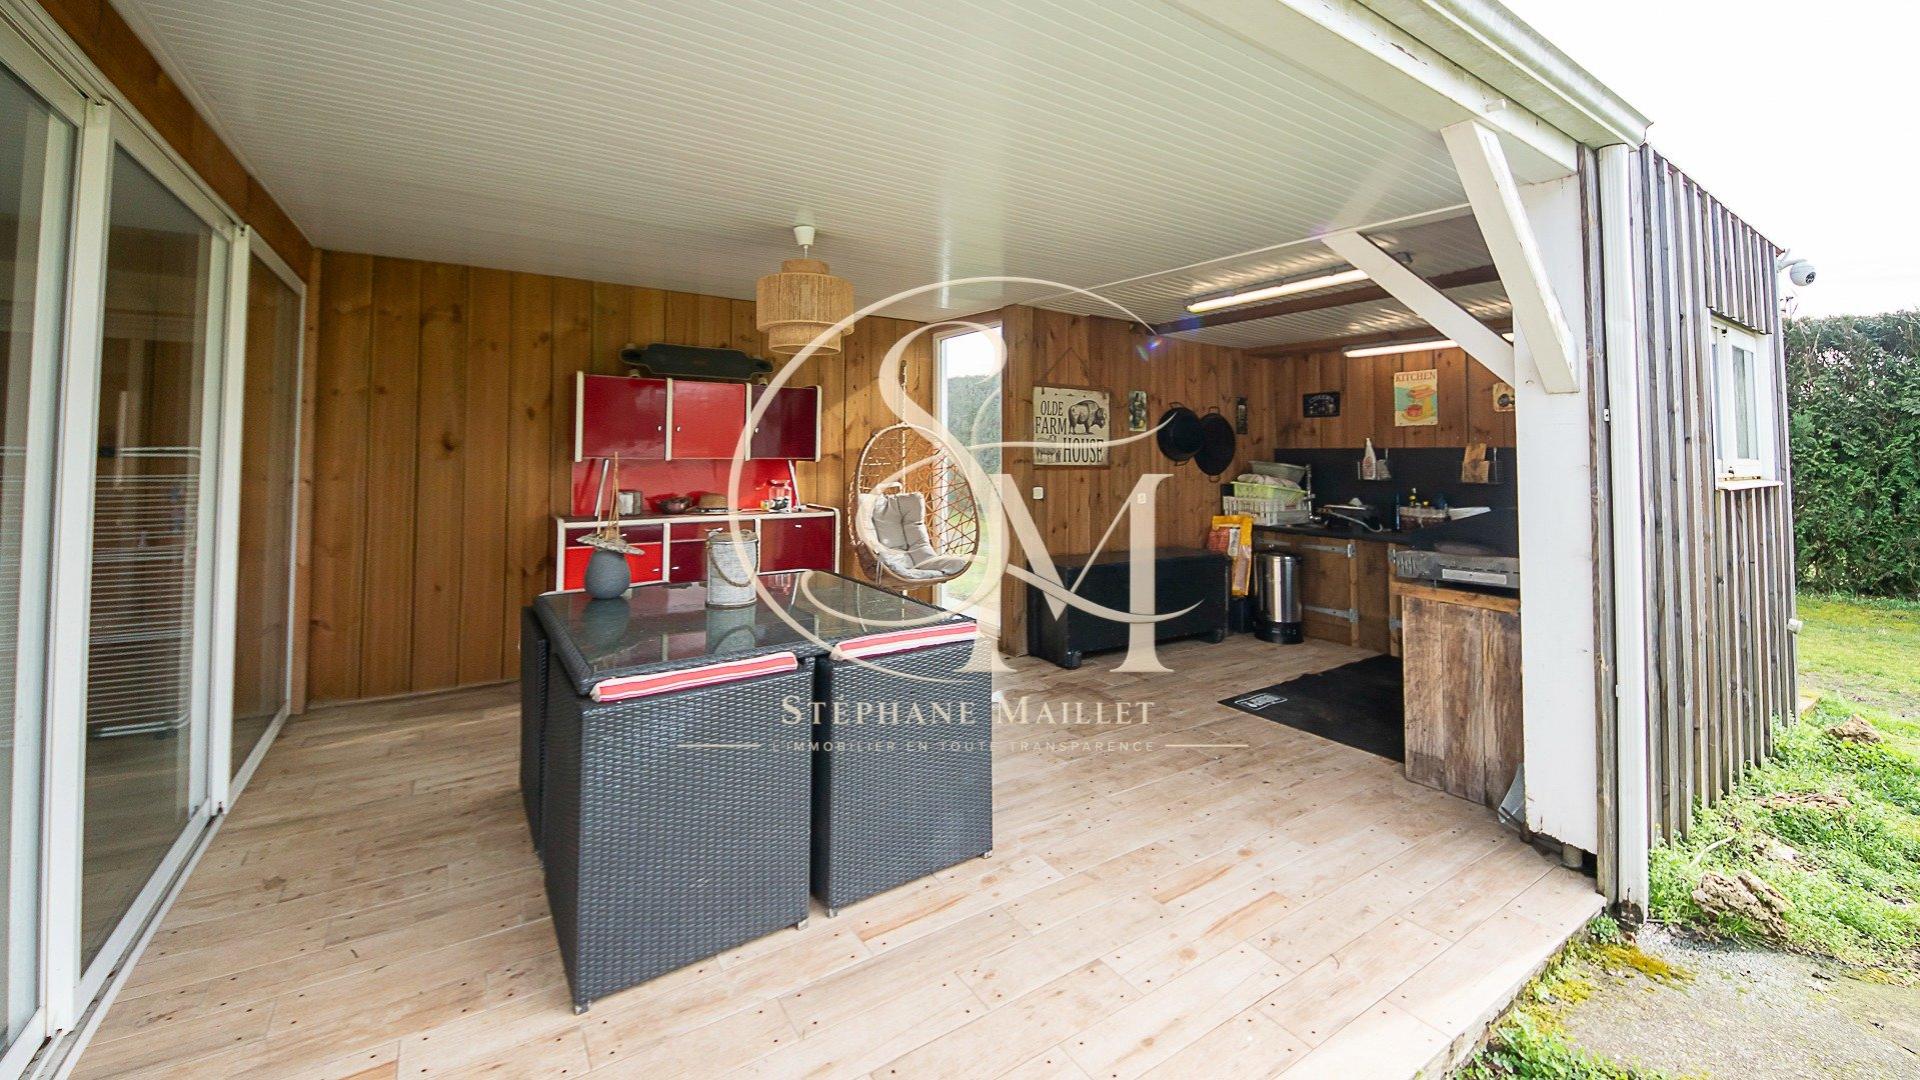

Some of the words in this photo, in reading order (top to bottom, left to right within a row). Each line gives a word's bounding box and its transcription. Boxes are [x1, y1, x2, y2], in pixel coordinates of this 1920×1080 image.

[1395, 371, 1437, 382] KITCHEN
[1041, 400, 1064, 416] OLDE
[1035, 416, 1068, 435] FARM
[1063, 437, 1105, 463] HOUSE
